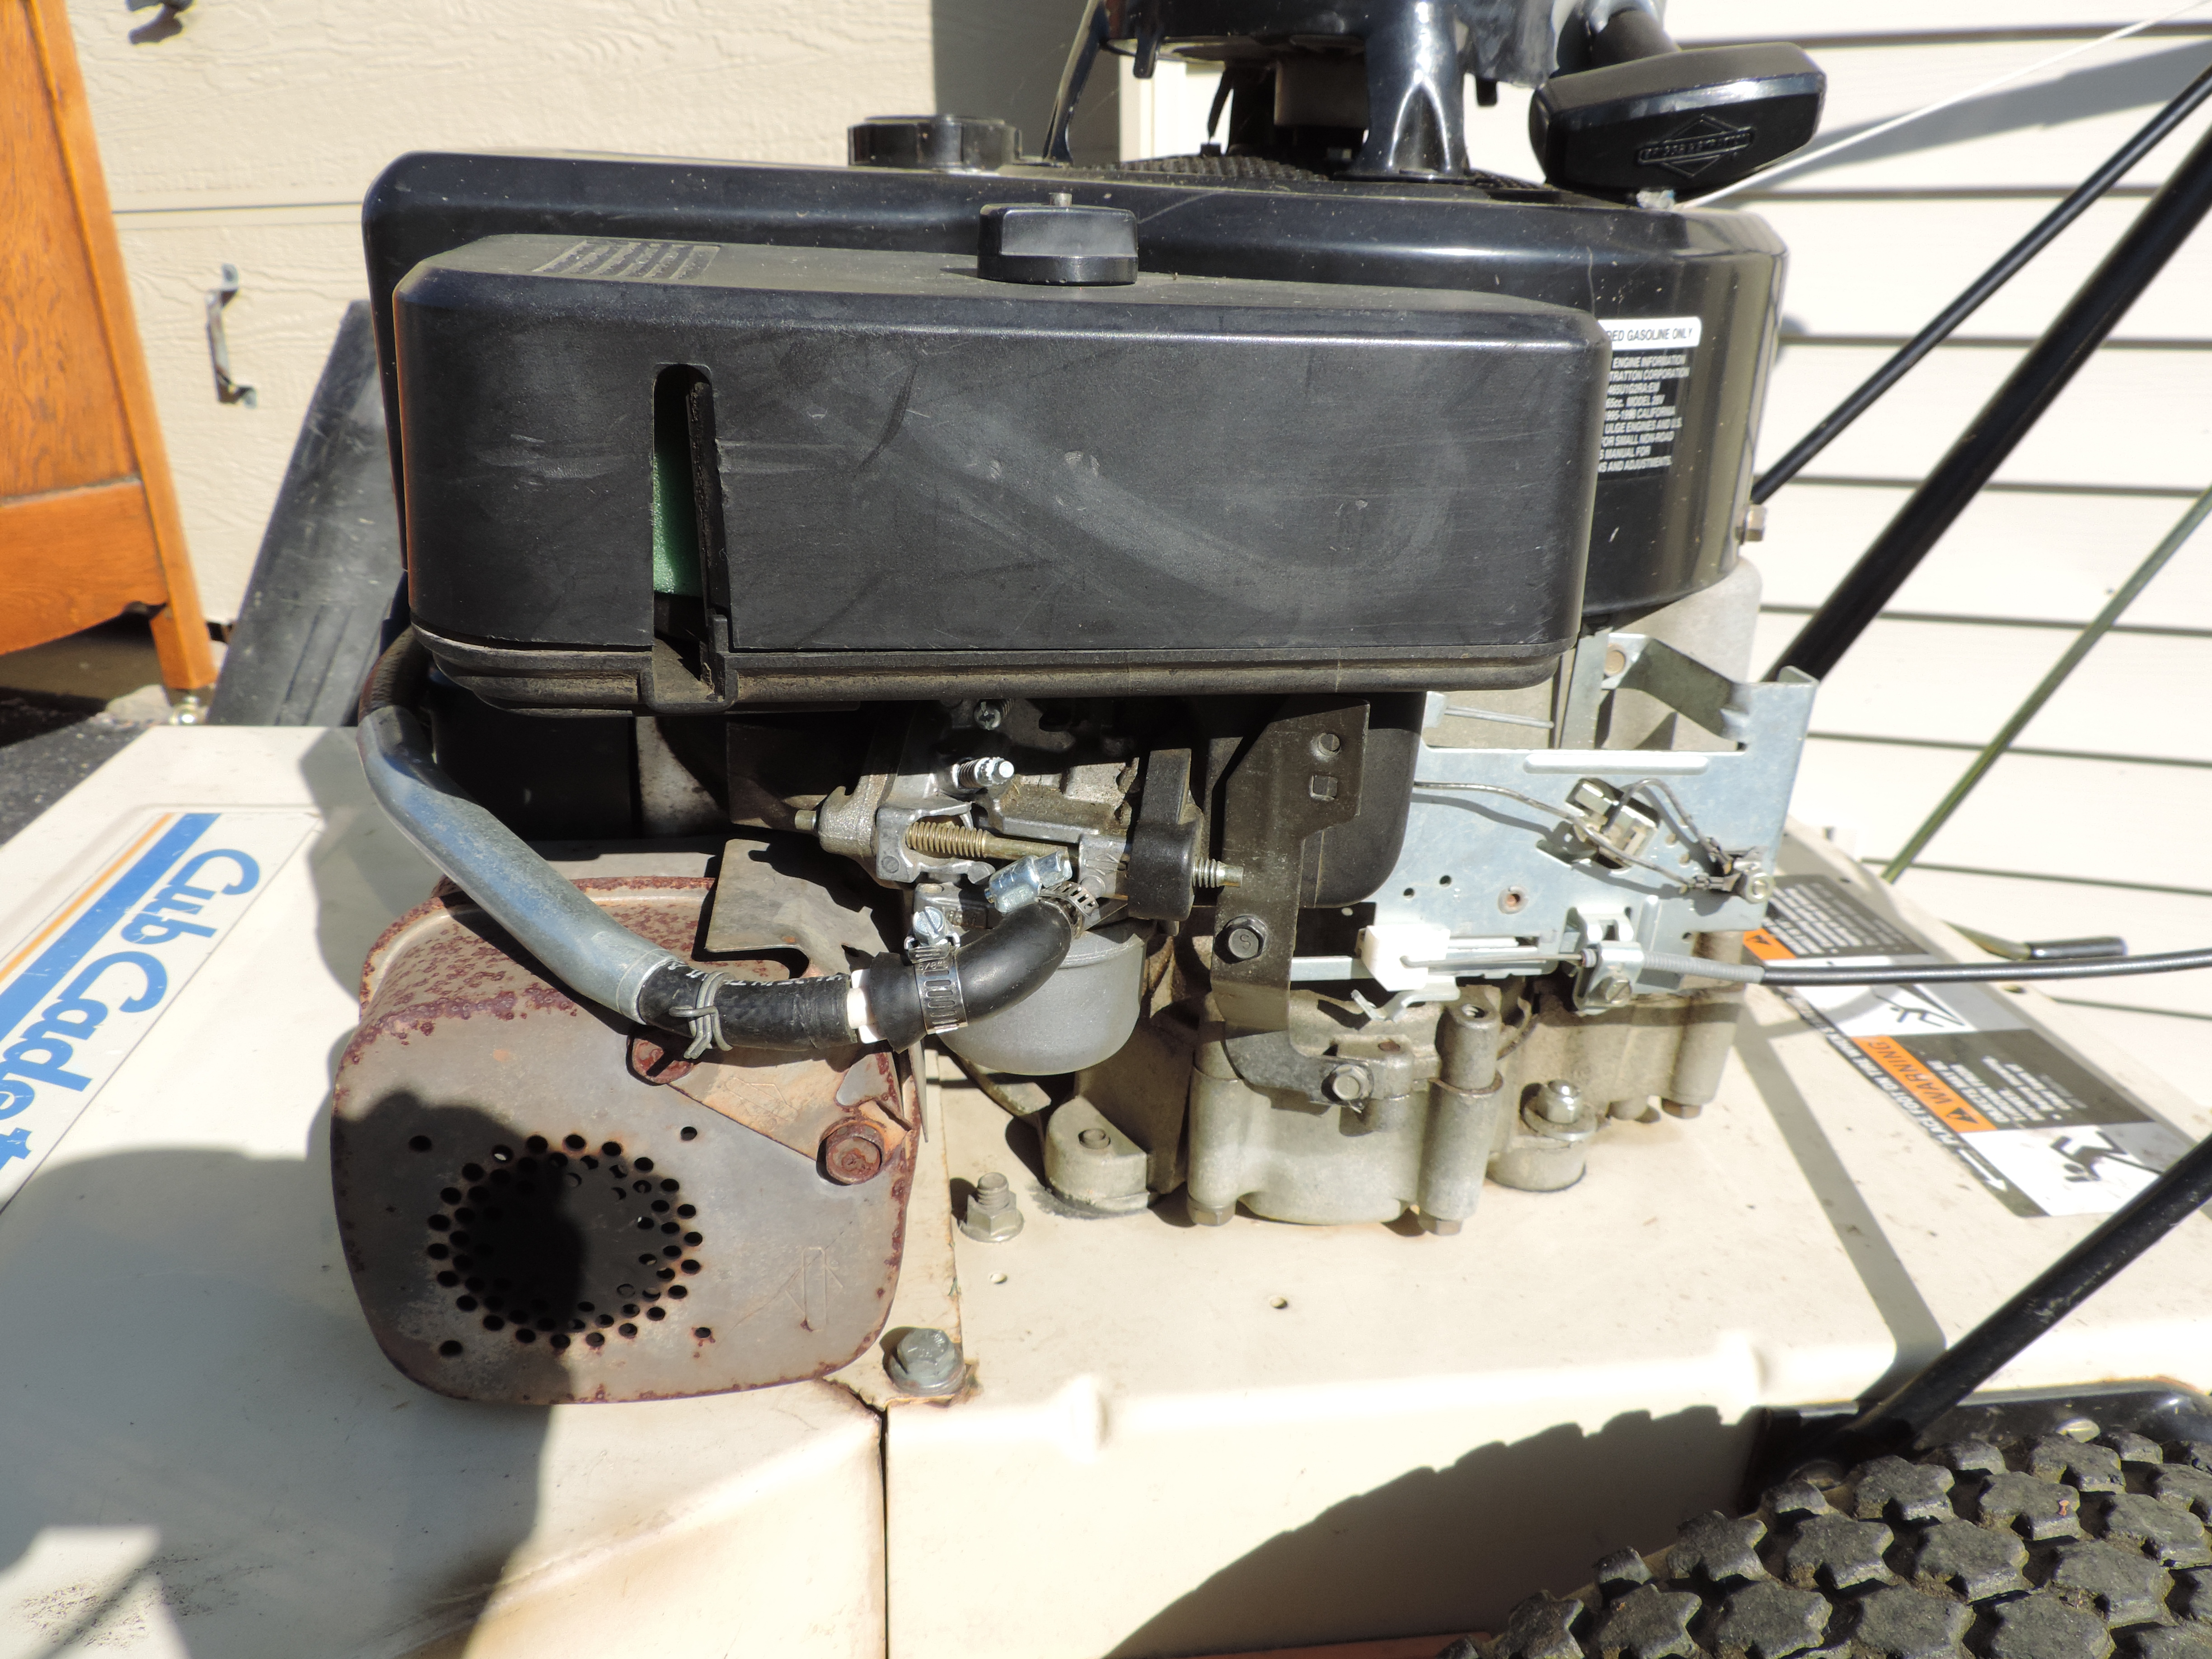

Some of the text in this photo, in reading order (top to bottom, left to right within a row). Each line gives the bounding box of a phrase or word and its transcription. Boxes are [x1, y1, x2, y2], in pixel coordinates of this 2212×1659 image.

[1627, 328, 1670, 341] GASOLINE
[1672, 328, 1693, 339] ONLY
[1612, 354, 1687, 370] ENGINE INFORMATION
[1643, 367, 1690, 380] CORPORATION
[1626, 395, 1651, 407] MODEL
[1636, 406, 1676, 419] CALIFORNIA
[1626, 420, 1657, 433] ENGINES
[1656, 418, 1671, 430] AND
[1614, 434, 1639, 446] SMALL
[1604, 446, 1636, 460] MANUAL
[1635, 445, 1652, 457] FOR
[1607, 460, 1625, 472] AND
[121, 848, 260, 945] Cub
[1868, 1041, 1953, 1104] WARNING
[1939, 1070, 1970, 1089] MAY
[1825, 1032, 1959, 1144] PLACE FOOT ON TIRE WHEN
